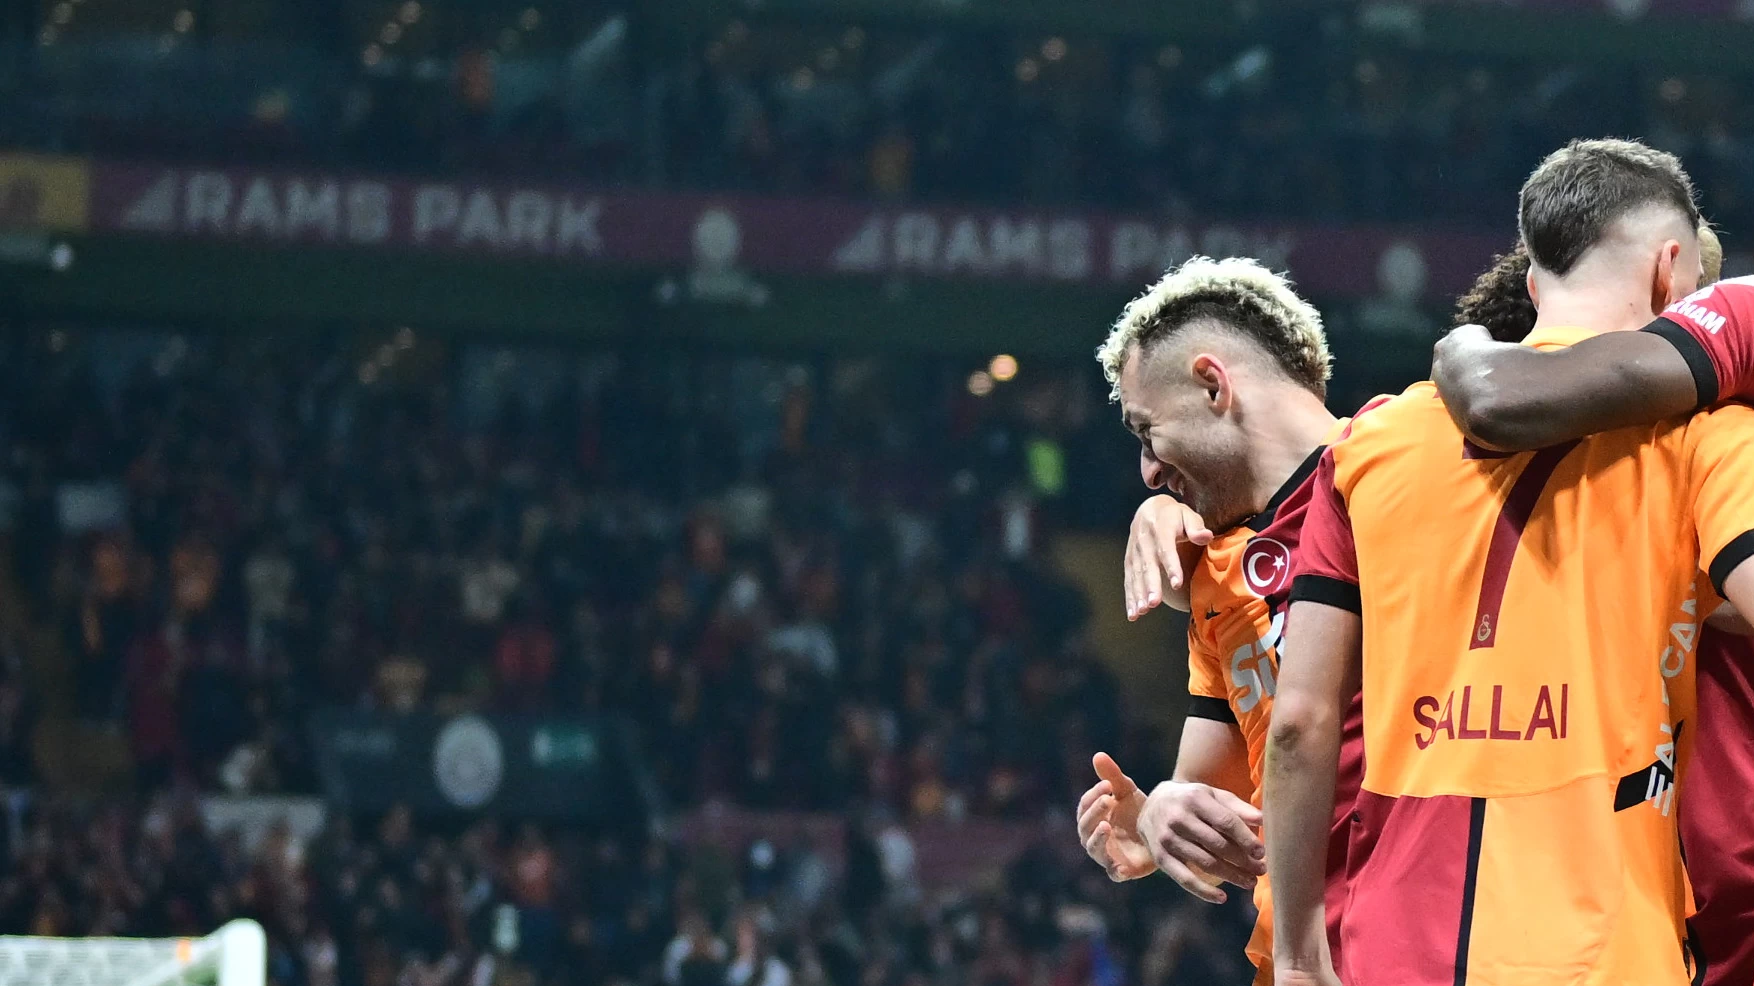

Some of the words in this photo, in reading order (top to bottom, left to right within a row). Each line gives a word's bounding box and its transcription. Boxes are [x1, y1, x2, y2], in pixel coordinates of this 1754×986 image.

[186, 171, 391, 243] RAMS
[413, 184, 602, 254] PARK
[890, 211, 1092, 279] RAMS
[1413, 683, 1568, 750] SALLAI
